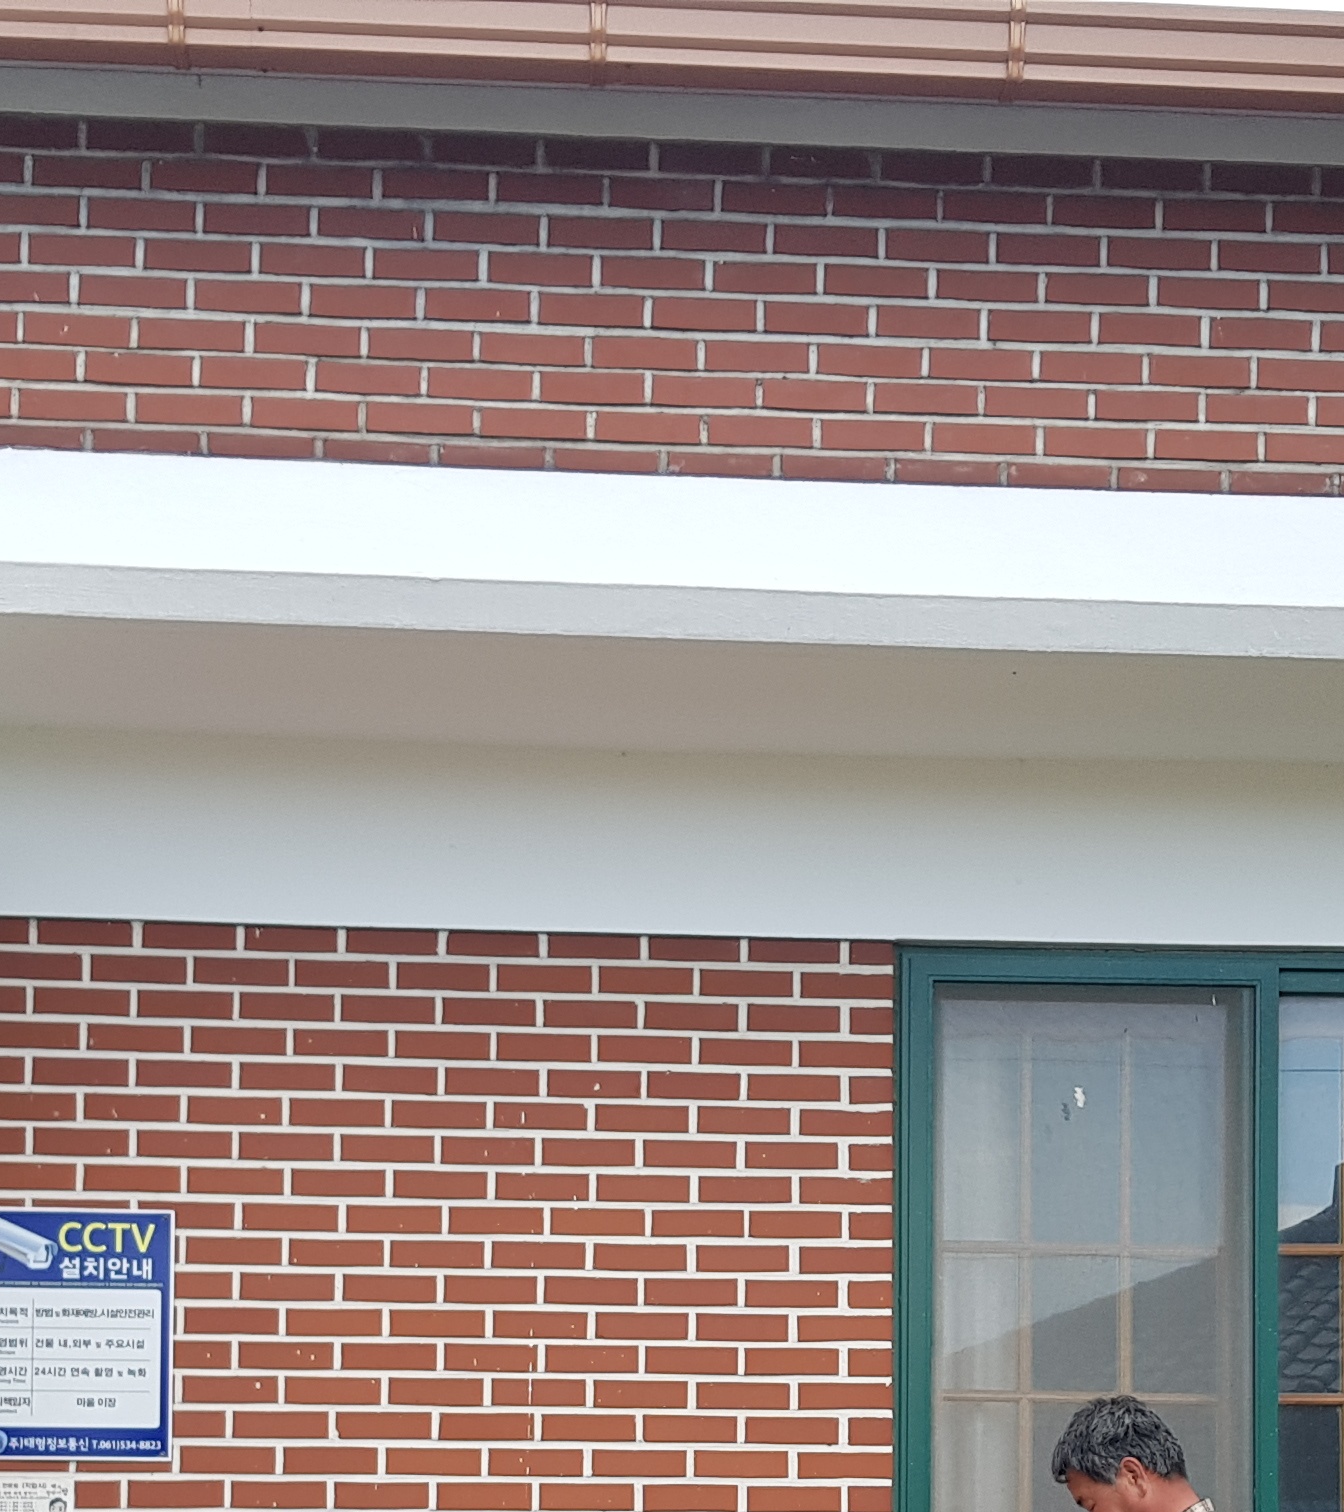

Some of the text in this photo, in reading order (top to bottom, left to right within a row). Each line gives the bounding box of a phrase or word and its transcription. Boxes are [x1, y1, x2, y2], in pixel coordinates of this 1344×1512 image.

[58, 1221, 155, 1253] CCTV
[59, 1257, 153, 1280] 설치안내
[34, 1366, 67, 1377] 24시간
